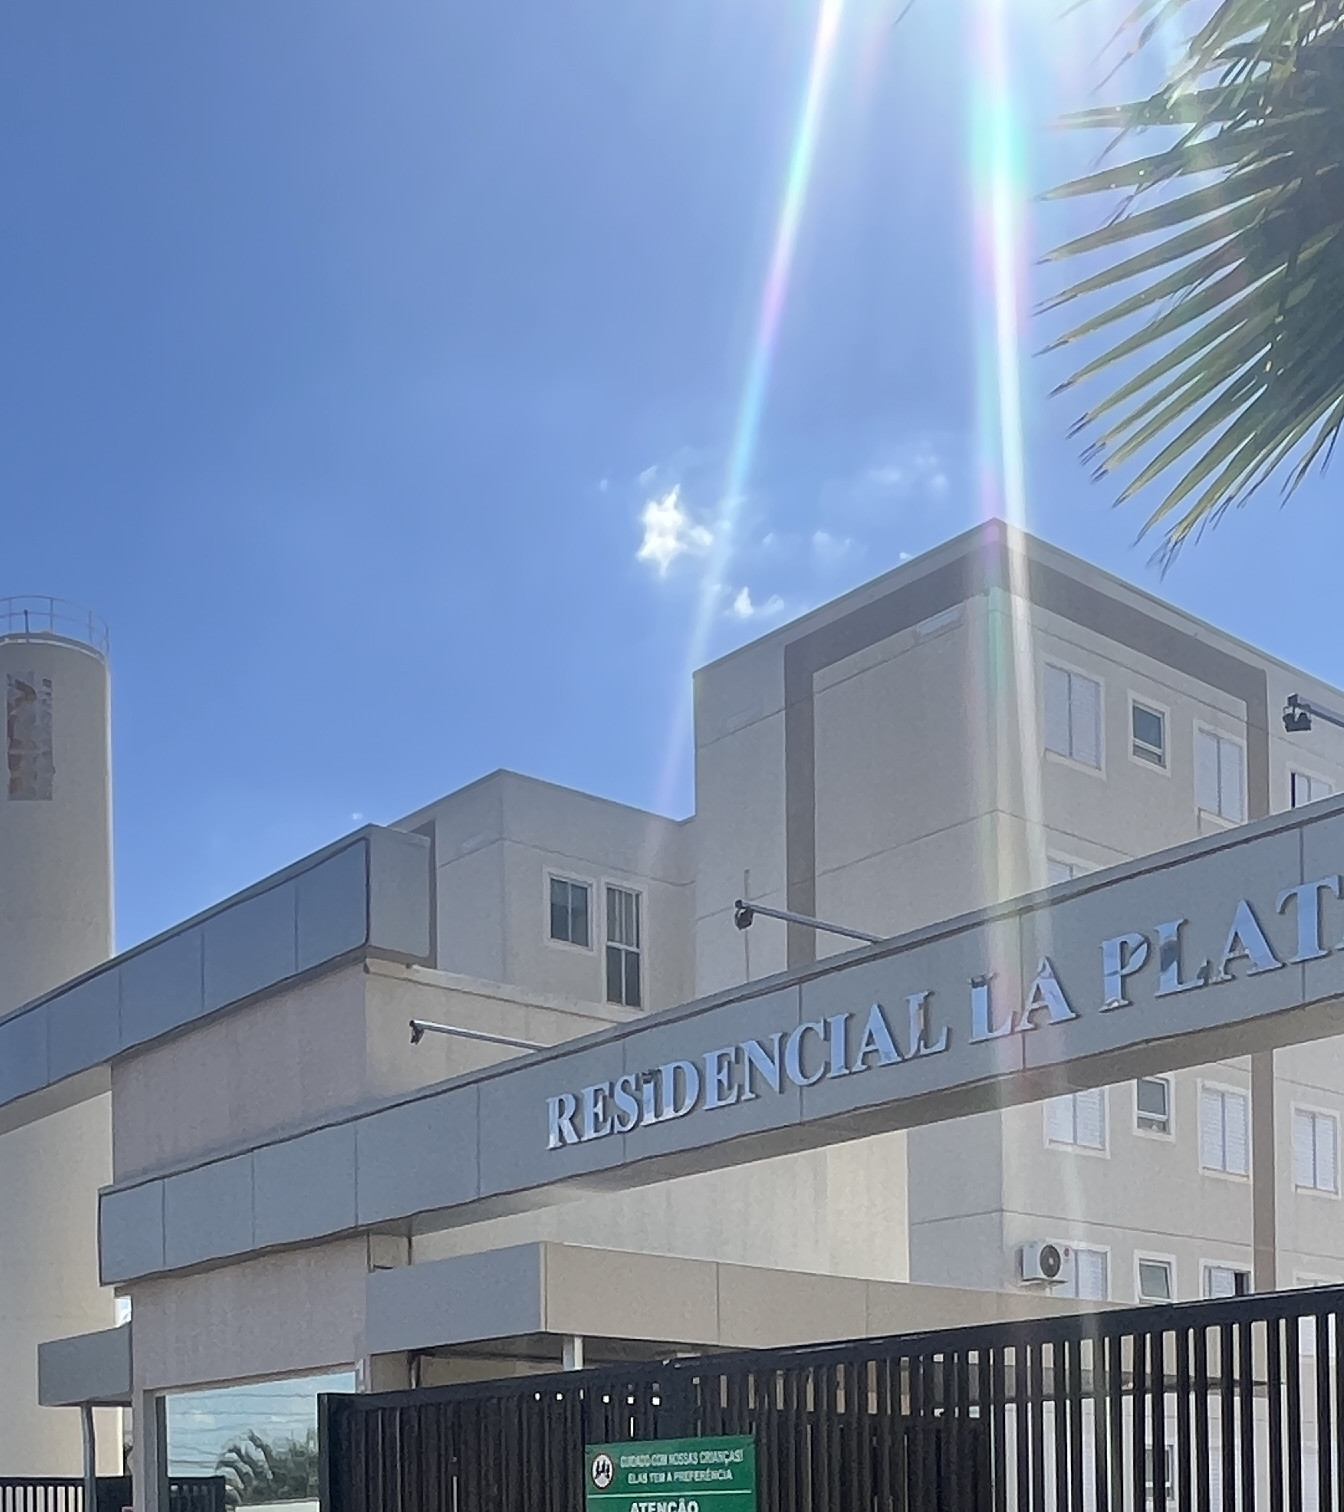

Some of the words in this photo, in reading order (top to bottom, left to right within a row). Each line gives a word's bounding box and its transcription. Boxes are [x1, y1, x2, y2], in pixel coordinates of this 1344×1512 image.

[545, 991, 951, 1150] RESIDENCIAL
[968, 956, 1077, 1044] LA
[669, 1452, 698, 1465] NOSSAS
[699, 1449, 743, 1466] CRIANÇAS!
[628, 1473, 647, 1484] ELAS
[667, 1472, 672, 1482] A
[674, 1468, 733, 1481] PREFERÊNCIA
